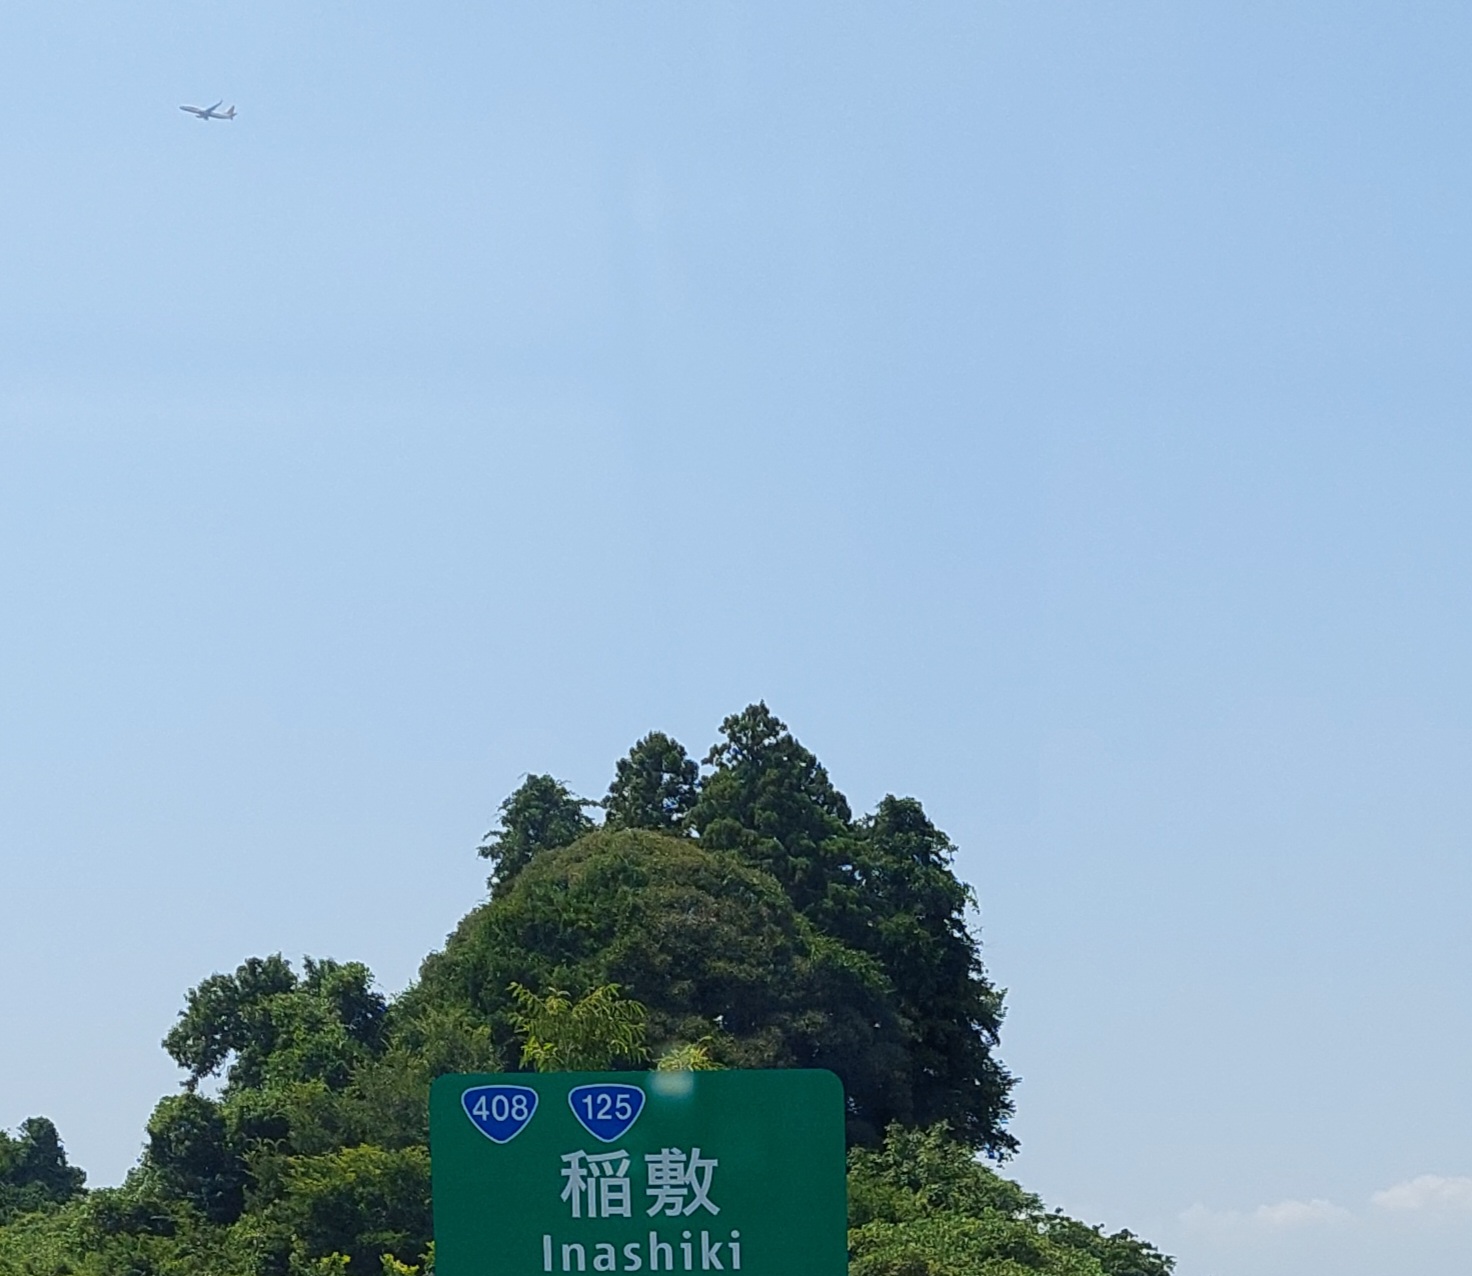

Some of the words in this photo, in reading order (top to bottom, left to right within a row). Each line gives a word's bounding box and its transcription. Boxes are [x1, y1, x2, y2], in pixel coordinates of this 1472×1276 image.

[473, 1094, 528, 1122] 408
[580, 1094, 633, 1120] 125
[560, 1147, 721, 1218] 稲敷
[543, 1230, 740, 1271] Inashiki
